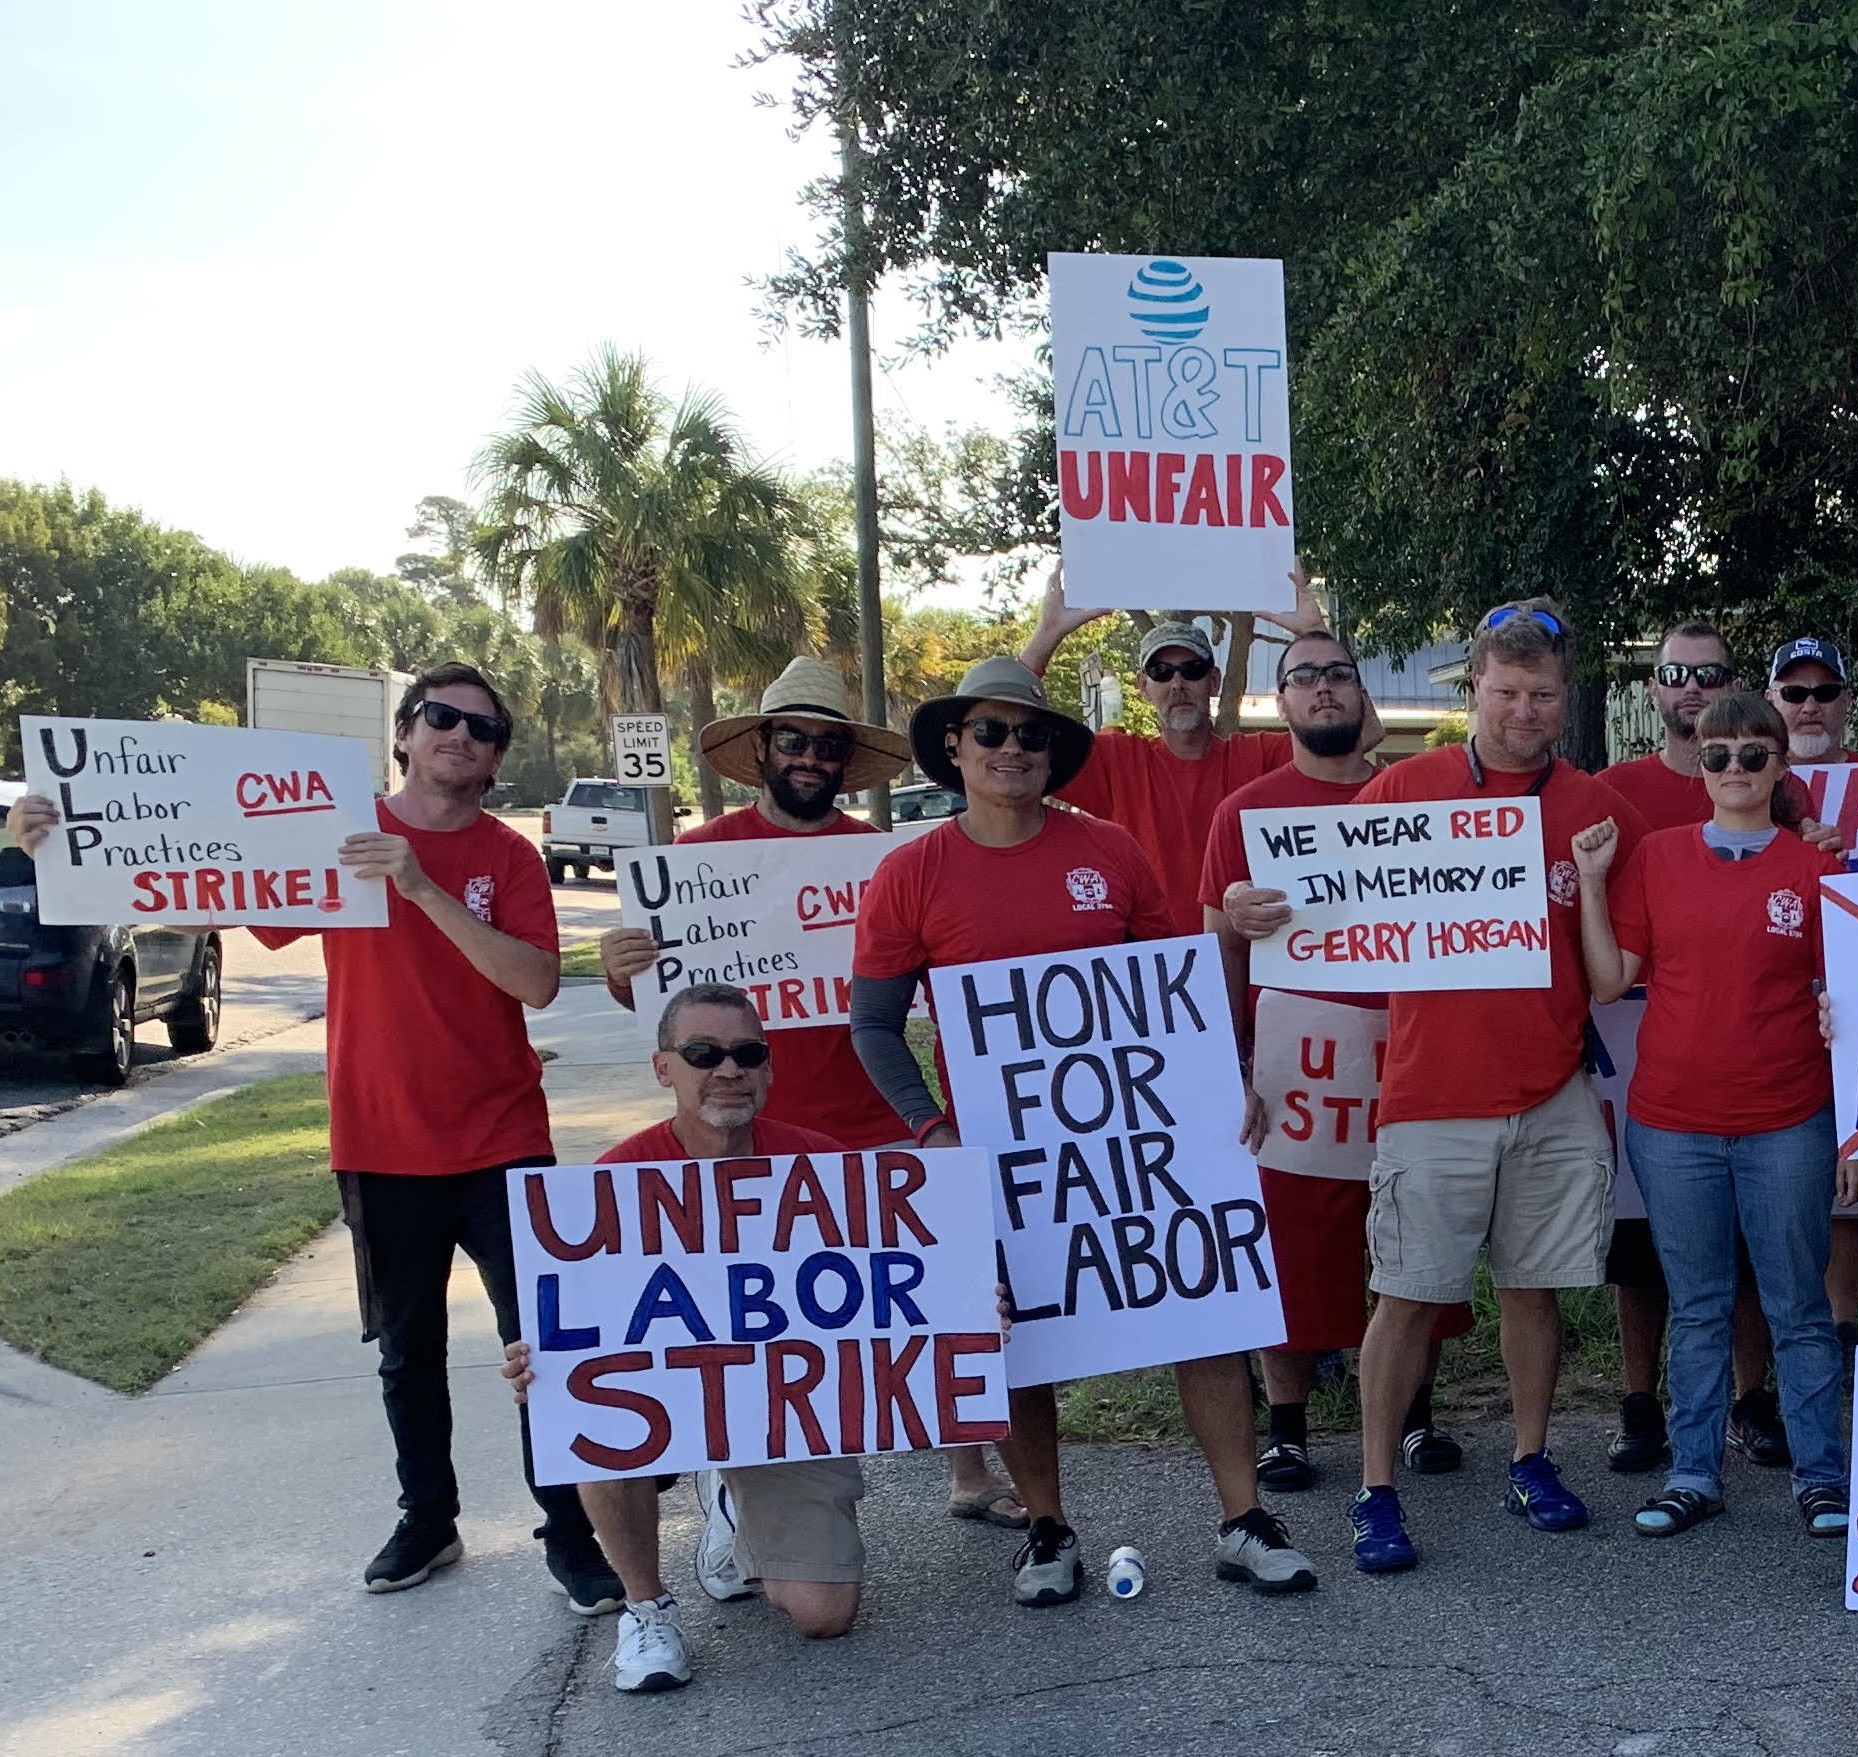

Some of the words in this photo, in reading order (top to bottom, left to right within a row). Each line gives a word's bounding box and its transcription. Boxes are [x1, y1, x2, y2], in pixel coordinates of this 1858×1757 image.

[1064, 345, 1281, 443] AT&T
[1059, 450, 1290, 529] UNFAIR
[39, 727, 187, 779] Unfair
[617, 721, 663, 733] SPEED
[623, 737, 659, 748] LIMIT
[236, 770, 334, 811] CWA
[623, 753, 665, 778] 35
[59, 782, 192, 823] Labor
[65, 825, 243, 867] Practices
[1260, 824, 1317, 859] WE
[1338, 813, 1432, 849] WEAR
[1450, 806, 1524, 839] RED
[131, 868, 343, 914] STRIKE!
[629, 855, 760, 911] Unfair
[1298, 872, 1346, 905] IN
[1356, 865, 1486, 903] MEMORY
[1492, 865, 1526, 890] OF
[650, 915, 757, 950] Labor
[1287, 921, 1416, 964] GERRY
[1427, 917, 1548, 959] HORGAN
[656, 950, 799, 994] Practices
[961, 948, 1207, 1057] HONK
[1000, 1044, 1177, 1141] FOR
[524, 1151, 938, 1262] UNFAIR
[998, 1130, 1194, 1232] FAIR
[996, 1198, 1272, 1324] LABOR
[536, 1250, 929, 1352] LABOR
[566, 1332, 1010, 1471] STRIKE
